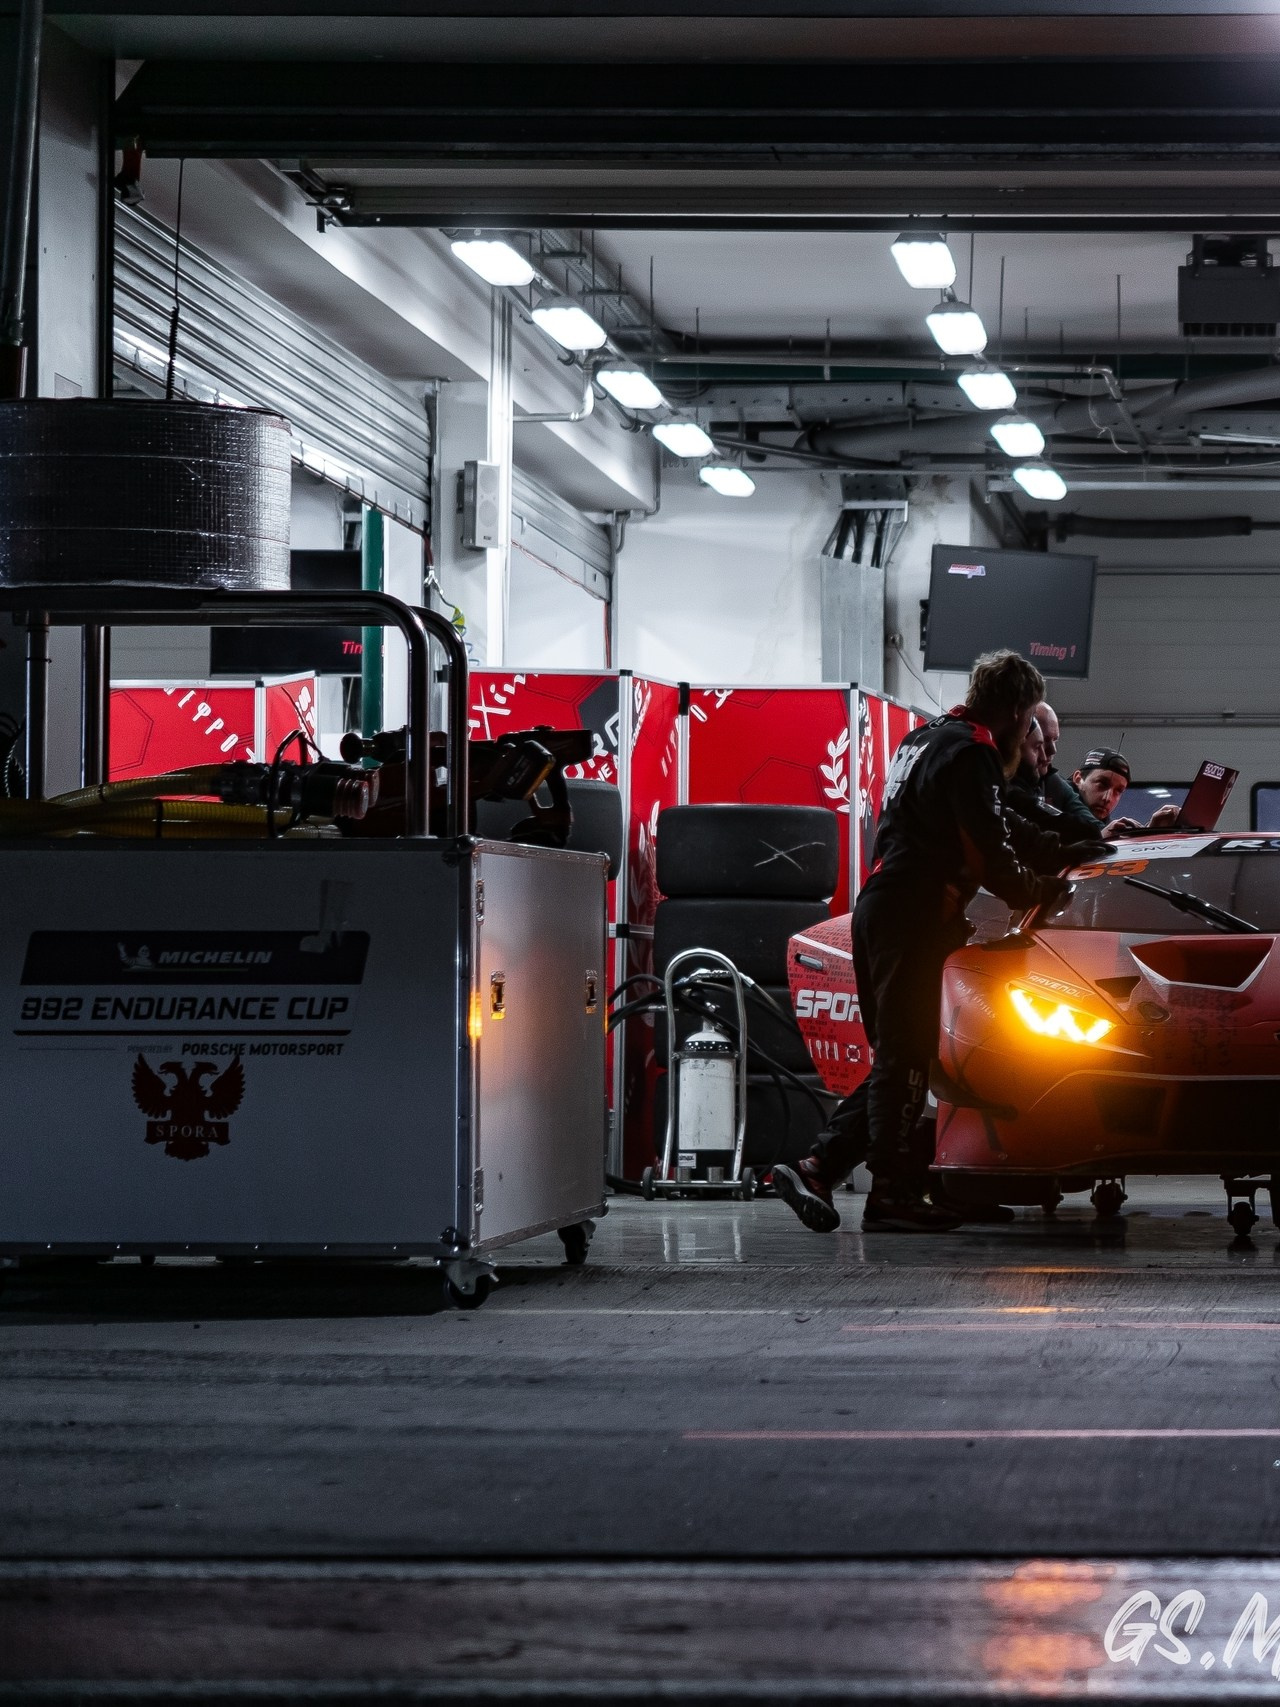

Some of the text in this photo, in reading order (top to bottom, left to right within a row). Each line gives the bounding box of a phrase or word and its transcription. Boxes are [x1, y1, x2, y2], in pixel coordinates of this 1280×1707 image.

[1029, 642, 1077, 660] Timing 1
[158, 951, 273, 964] MICHELIN
[1028, 975, 1081, 998] RAVENOL
[21, 997, 348, 1020] 992 ENDURANCE CUP
[182, 1043, 246, 1056] PORSCHE
[249, 1043, 344, 1056] MOTORSPORT
[155, 1124, 219, 1139] SPORA
